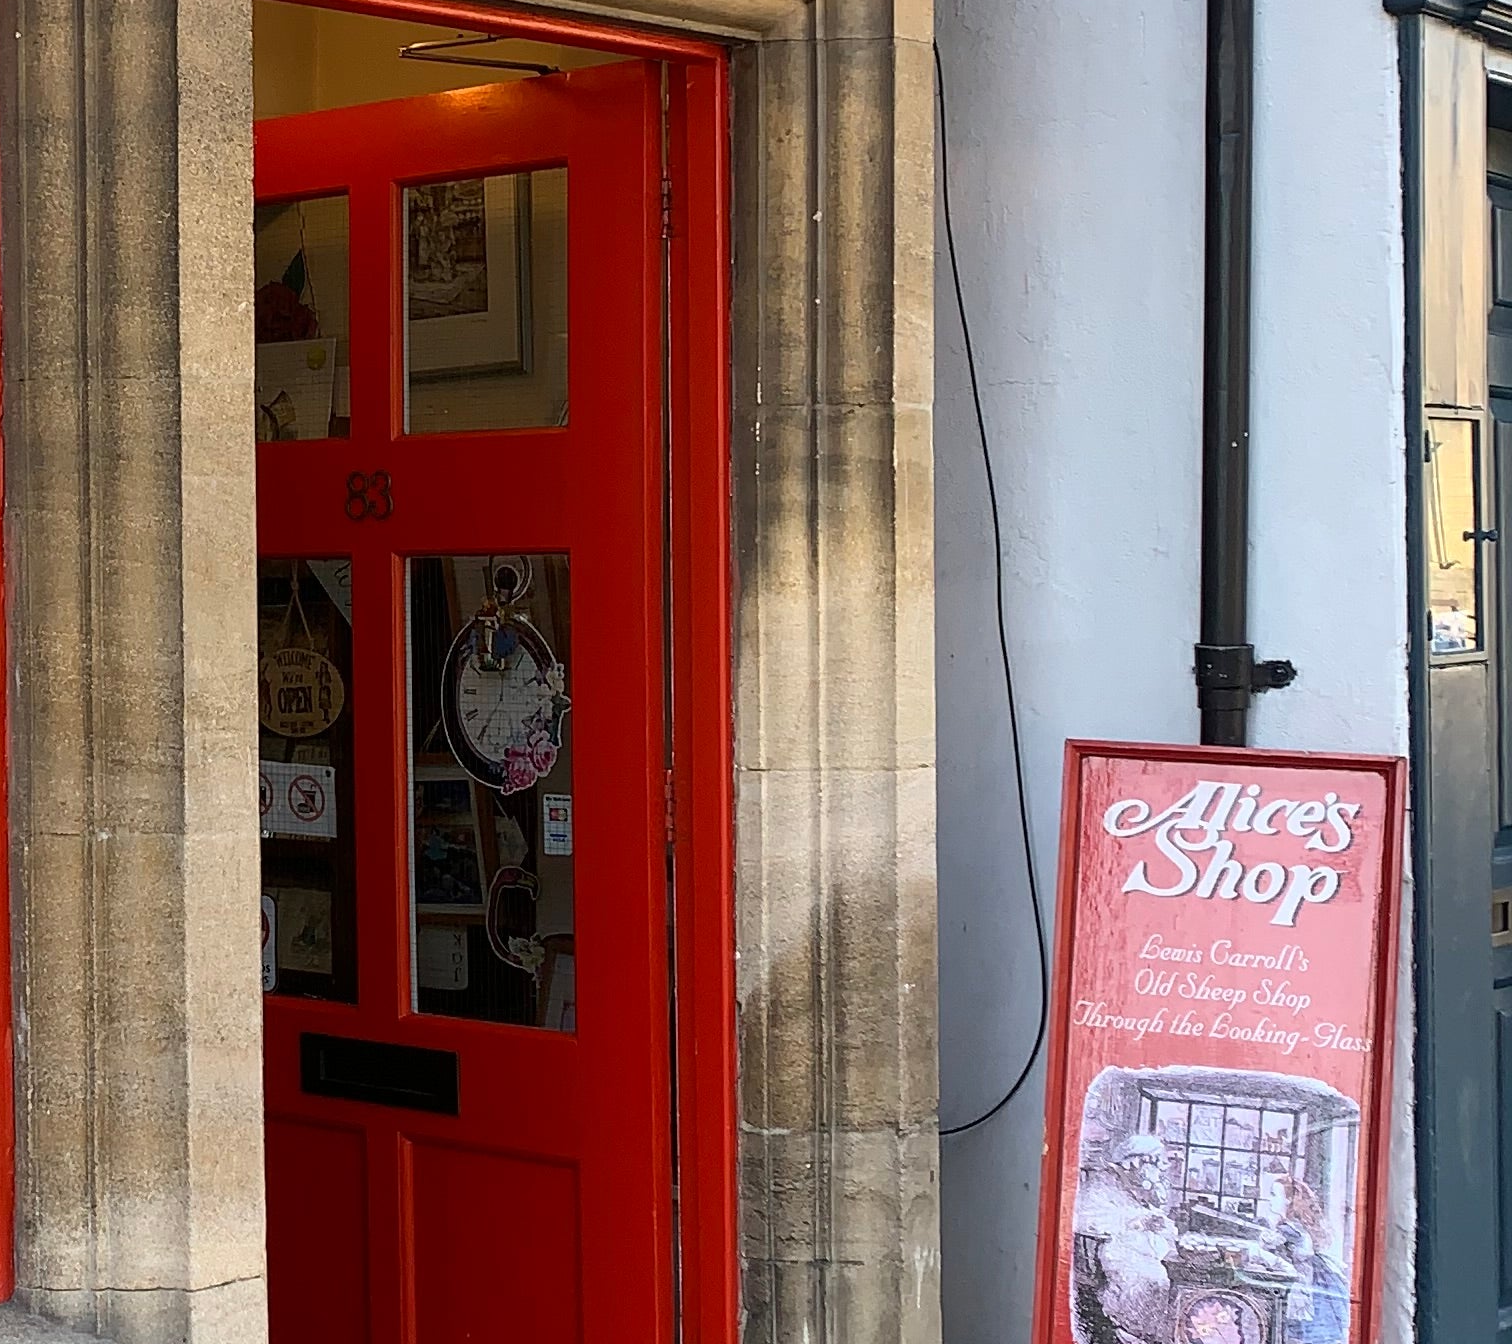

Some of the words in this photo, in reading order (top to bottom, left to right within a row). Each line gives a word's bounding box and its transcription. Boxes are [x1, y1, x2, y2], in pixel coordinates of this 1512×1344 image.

[345, 470, 394, 520] 83
[277, 686, 313, 714] OPEN
[1103, 780, 1363, 854] Alice's
[1121, 821, 1344, 927] Shop
[1139, 933, 1203, 964] Lewis
[1210, 939, 1310, 973] Carroll's
[1134, 968, 1172, 997] Old
[1178, 972, 1247, 1011] Sheep
[1253, 978, 1312, 1017] Shop
[1074, 999, 1164, 1041] Through
[1169, 1008, 1203, 1038] the
